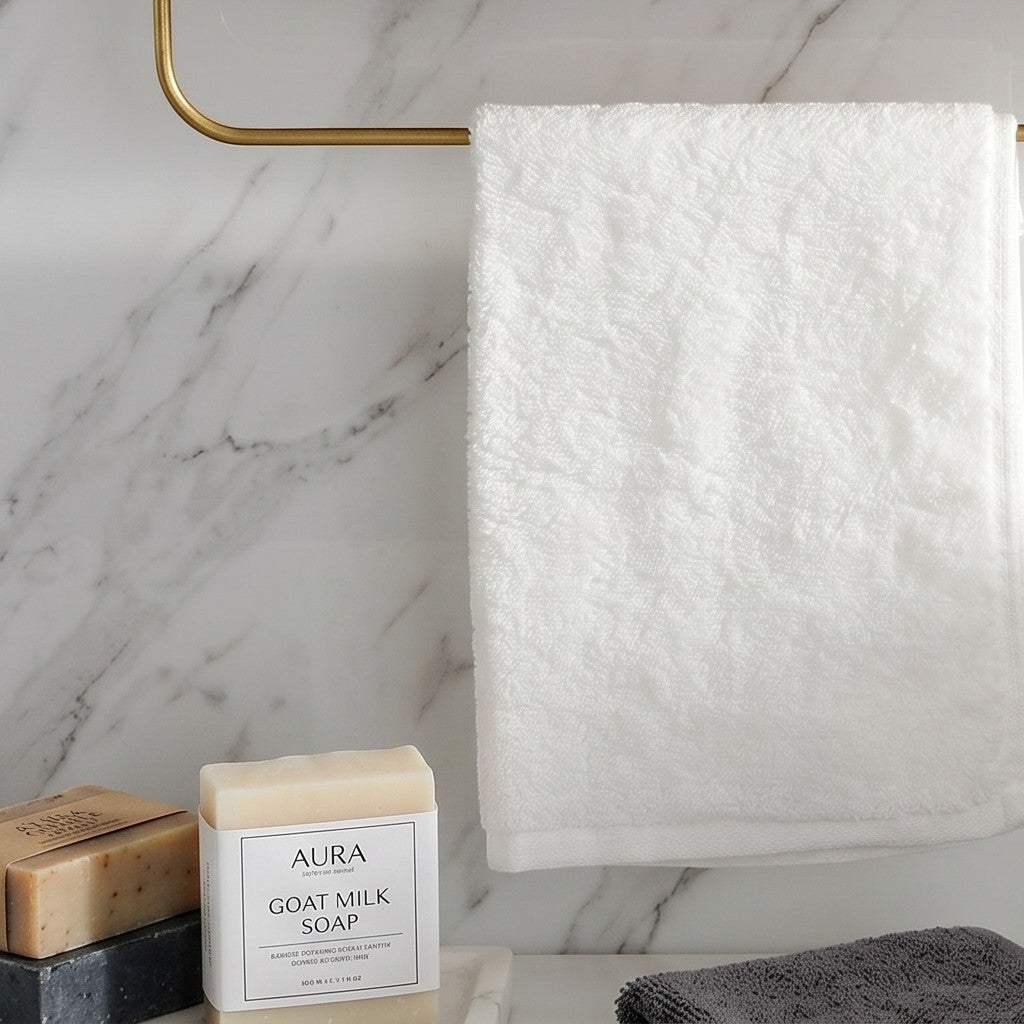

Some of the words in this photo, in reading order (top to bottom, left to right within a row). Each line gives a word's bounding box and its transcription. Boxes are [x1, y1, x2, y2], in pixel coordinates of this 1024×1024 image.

[291, 843, 367, 869] AURA
[269, 893, 330, 915] GOAT
[336, 887, 391, 908] MILK
[301, 913, 359, 935] SOAP
